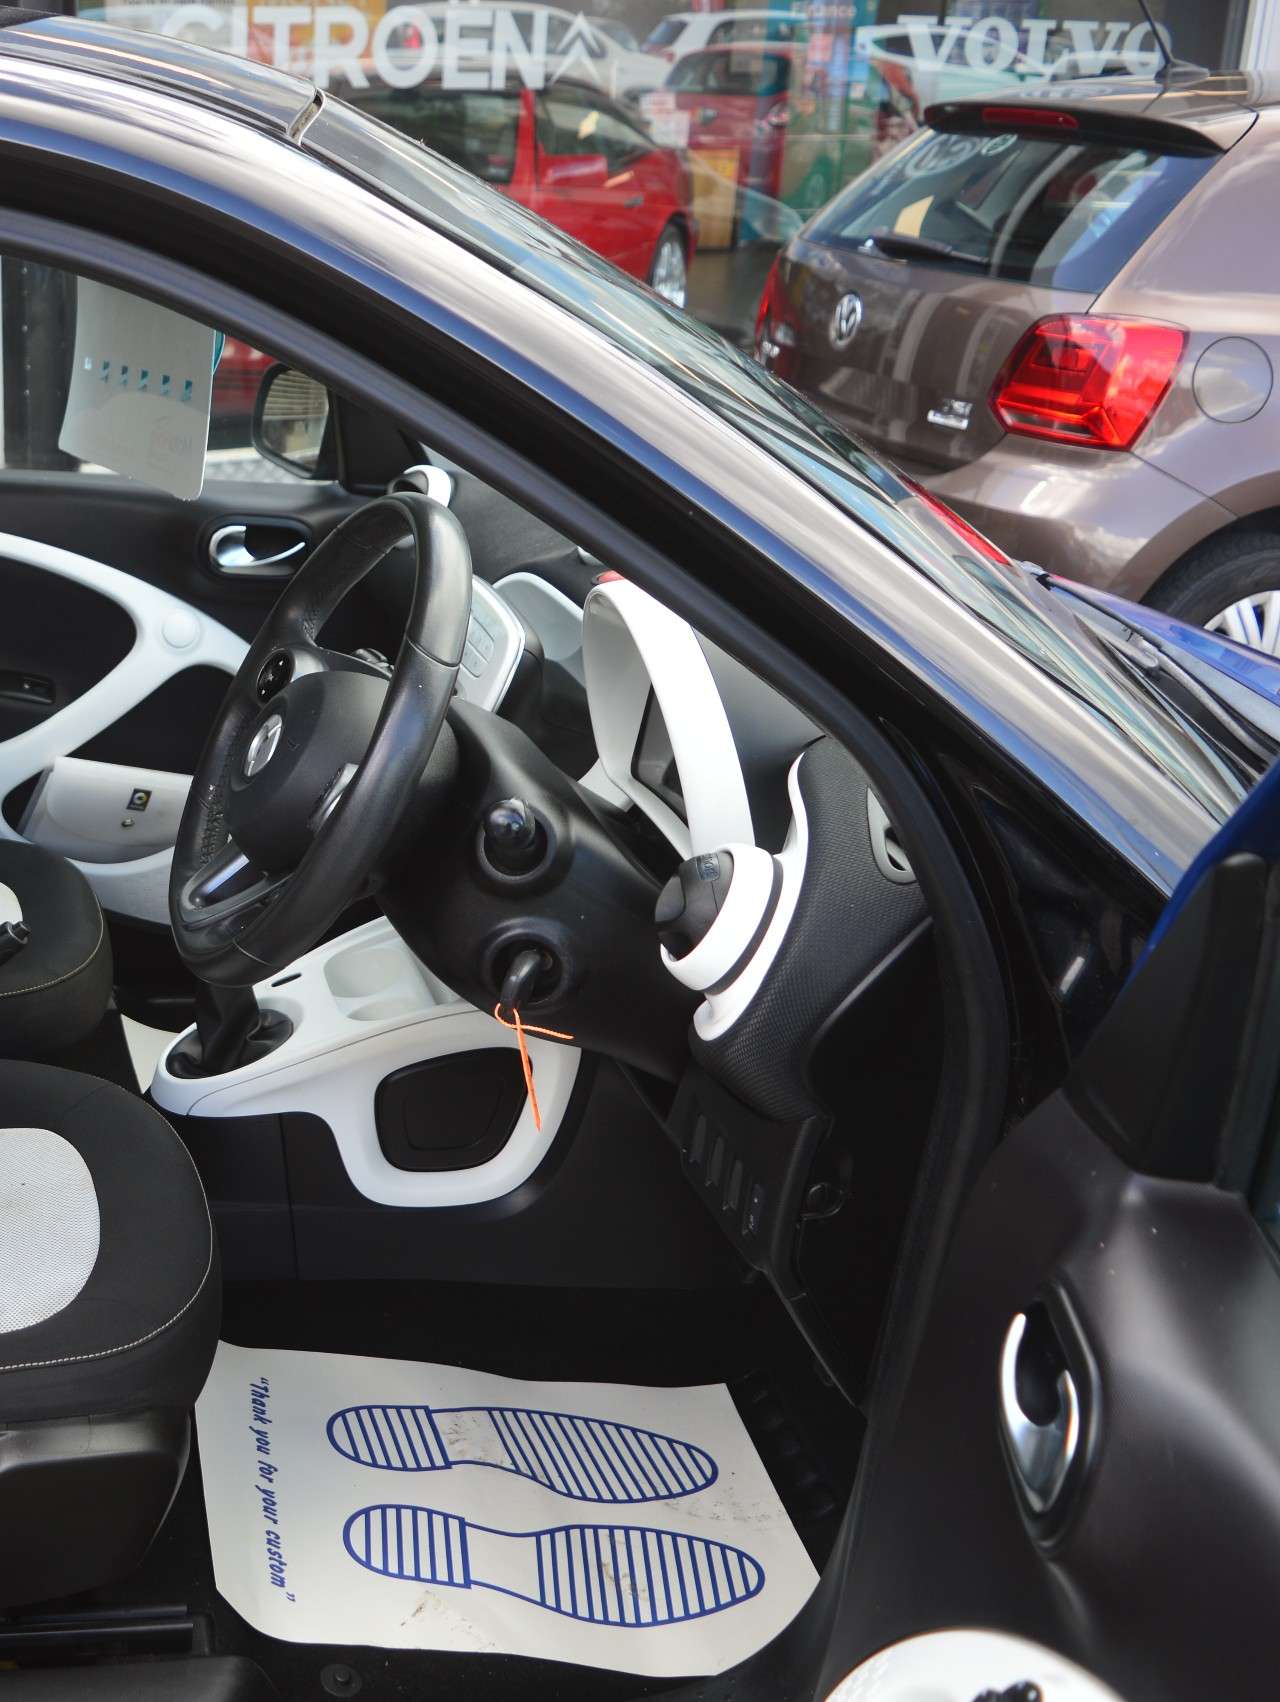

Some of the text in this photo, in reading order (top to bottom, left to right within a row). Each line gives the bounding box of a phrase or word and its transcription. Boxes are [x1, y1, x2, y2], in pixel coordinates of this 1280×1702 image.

[897, 15, 1172, 75] VOLVO
[249, 1425, 270, 1455] you
[257, 1460, 278, 1483] for
[255, 1484, 279, 1525] your
